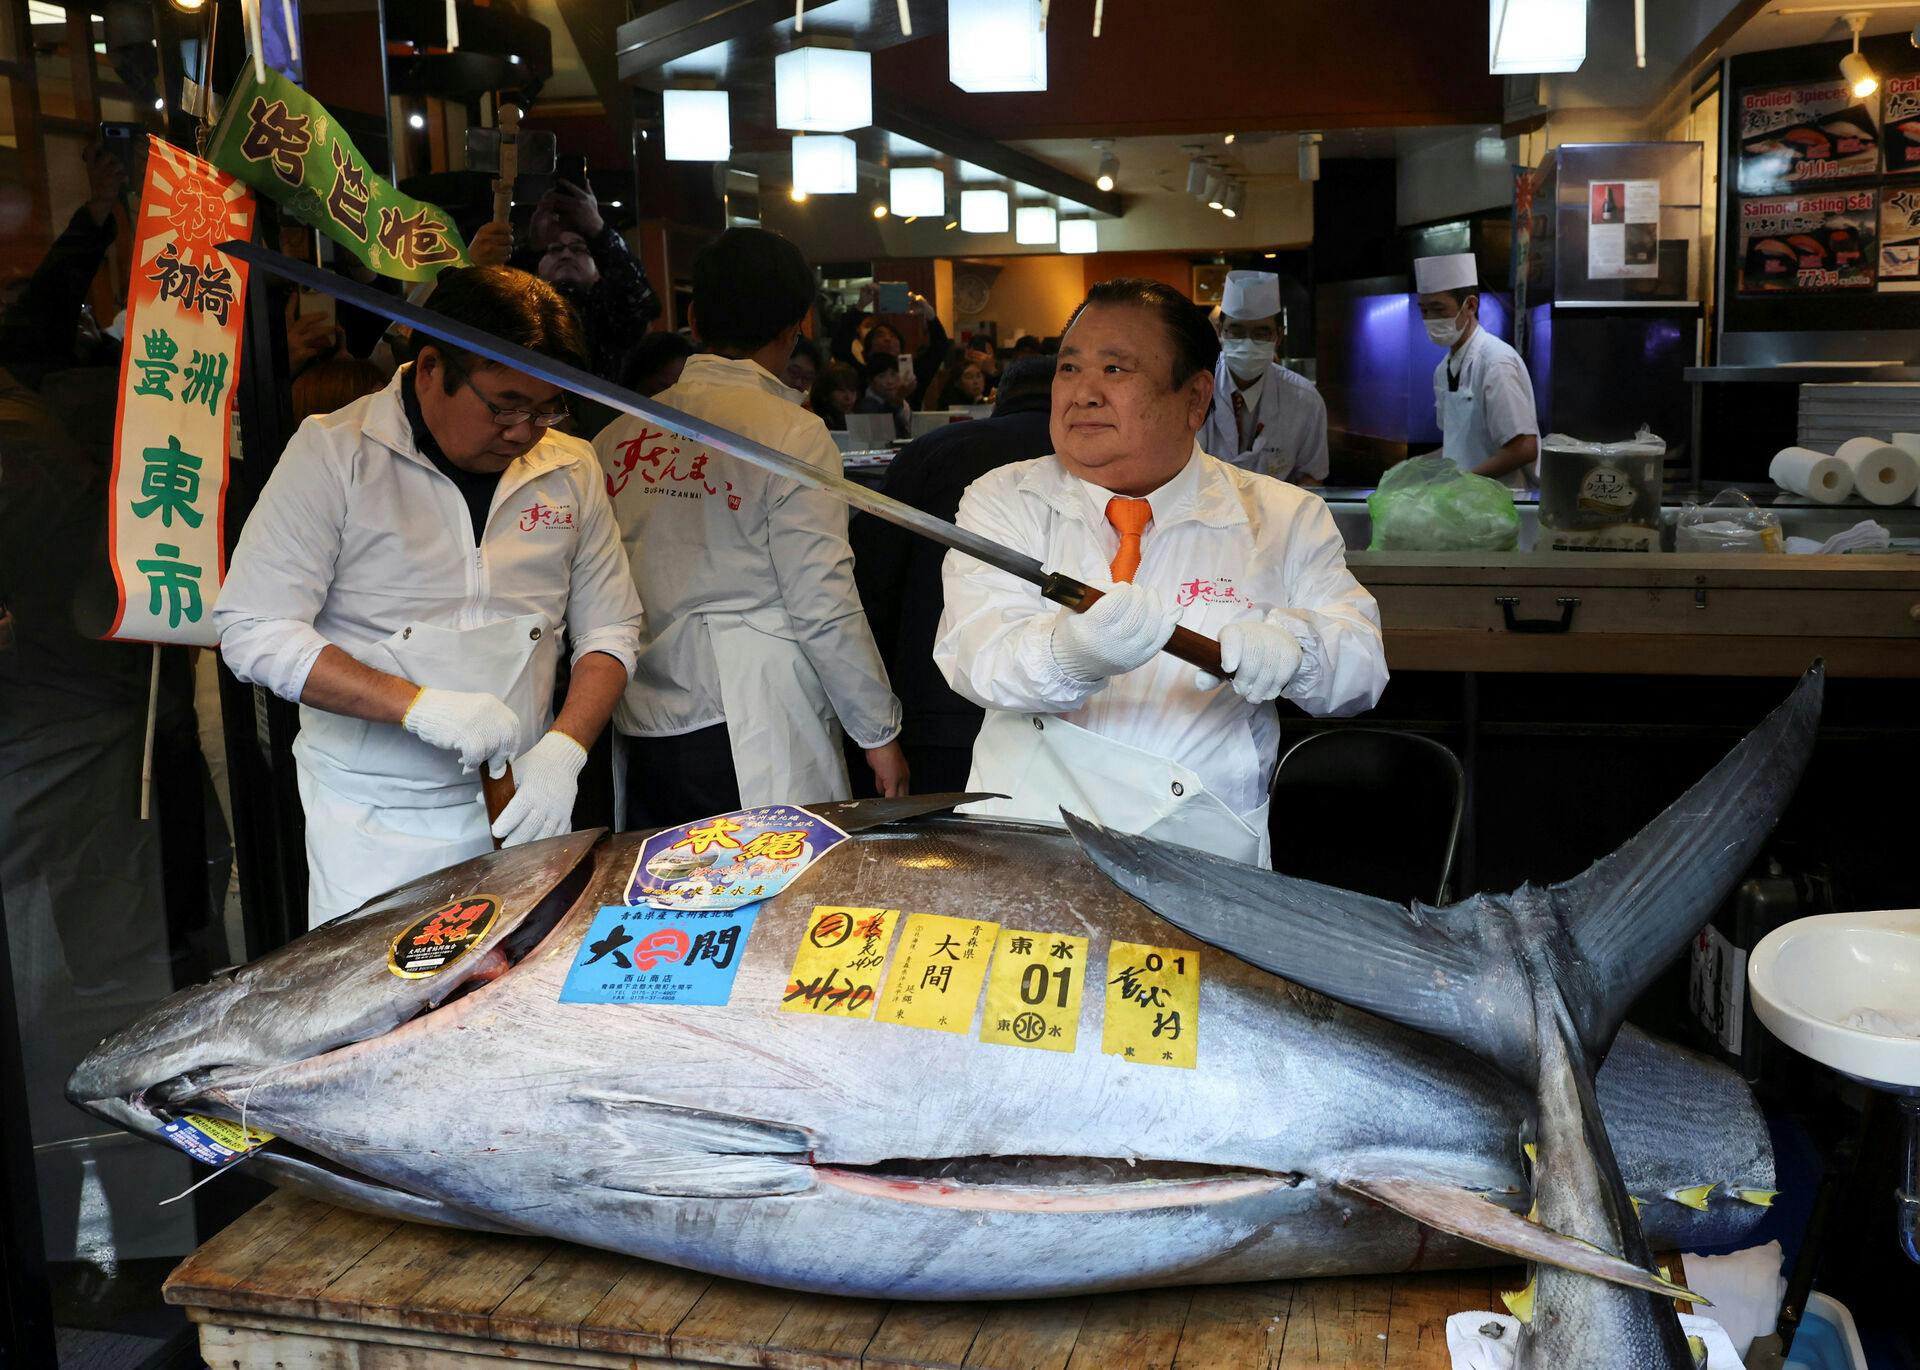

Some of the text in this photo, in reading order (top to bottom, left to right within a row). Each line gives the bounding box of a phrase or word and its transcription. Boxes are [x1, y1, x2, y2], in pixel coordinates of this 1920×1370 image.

[1745, 92, 1792, 109] Broiled
[168, 178, 230, 245] 祝
[1796, 197, 1844, 213] Tasting
[1848, 194, 1872, 209] Set
[147, 243, 235, 328] 初荷
[133, 328, 229, 417] 豊洲
[644, 487, 702, 500] SUSHIZANMAI
[130, 434, 204, 629] 東市
[963, 924, 984, 960] 青森県
[623, 974, 674, 983] 西山商店
[919, 933, 962, 995] 大間
[1145, 953, 1186, 975] 01
[1020, 963, 1072, 1008] 01
